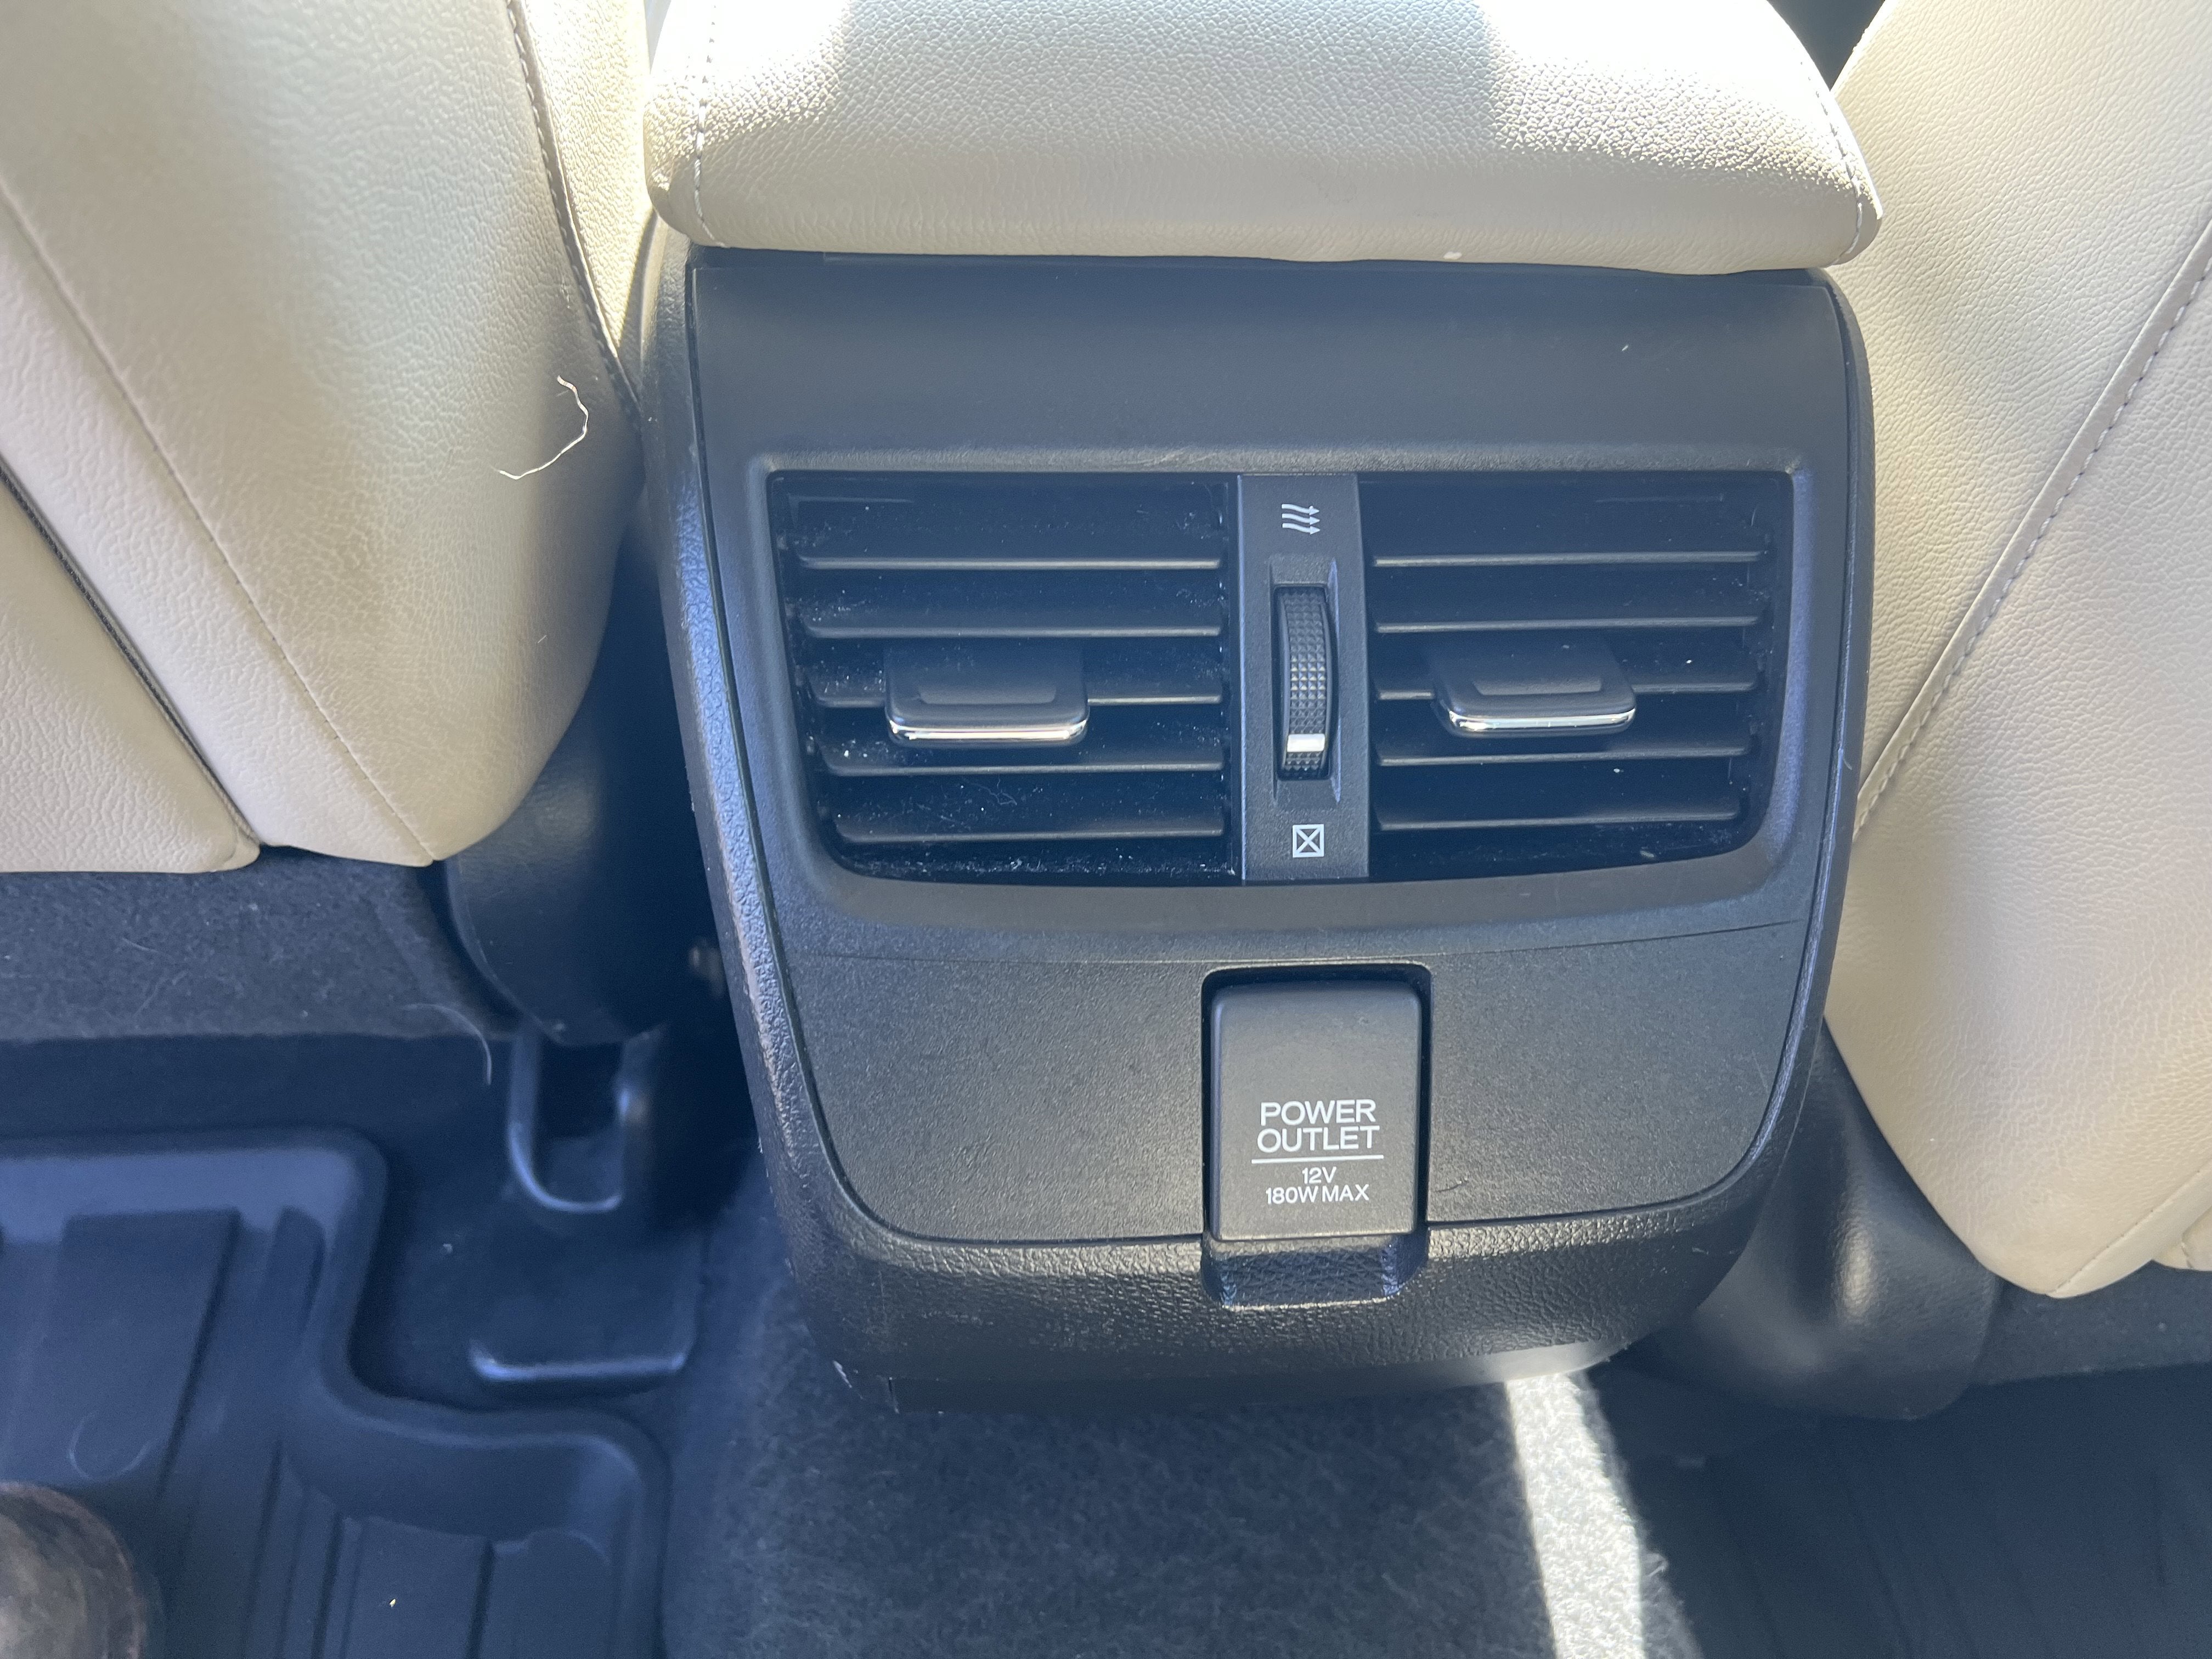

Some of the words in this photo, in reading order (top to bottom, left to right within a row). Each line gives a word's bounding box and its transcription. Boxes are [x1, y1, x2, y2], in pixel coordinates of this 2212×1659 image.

[1260, 1099, 1376, 1126] POWER
[1257, 1125, 1380, 1153] OUTLET
[1302, 1166, 1337, 1184] 12V
[1265, 1186, 1318, 1205] 180W
[1322, 1184, 1369, 1202] MAX
